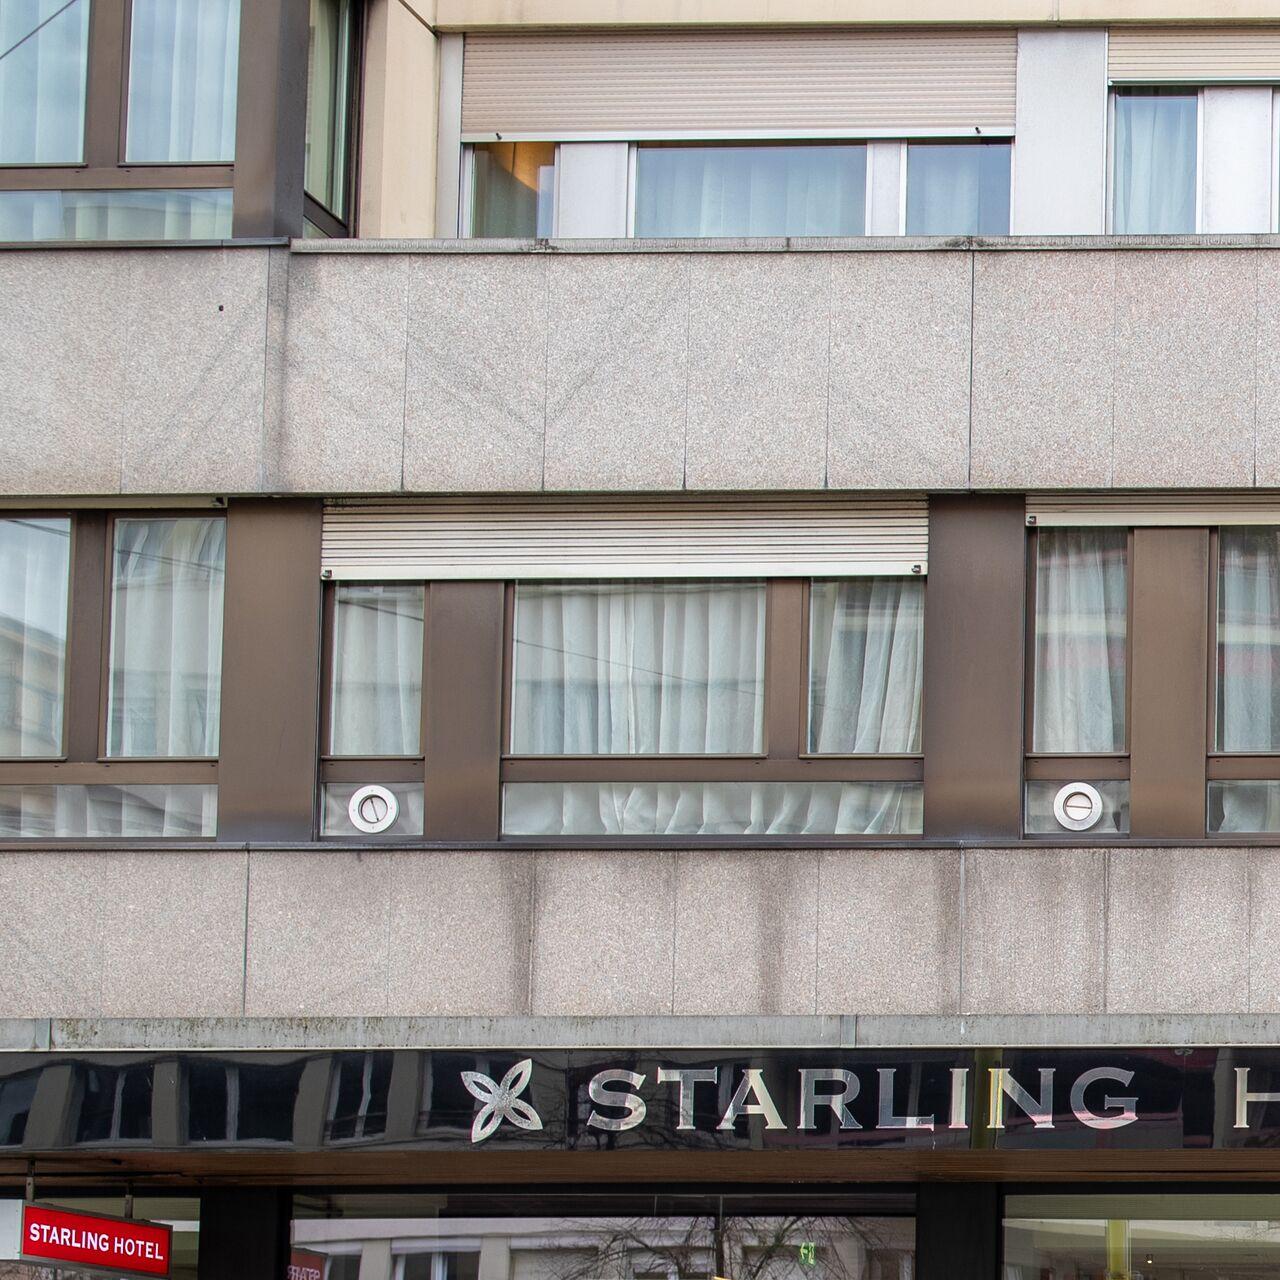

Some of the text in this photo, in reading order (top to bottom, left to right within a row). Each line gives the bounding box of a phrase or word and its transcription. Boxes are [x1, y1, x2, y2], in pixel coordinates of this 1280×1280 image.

[586, 1065, 1140, 1132] STARLING
[29, 1222, 164, 1261] STARLING HOTEL
